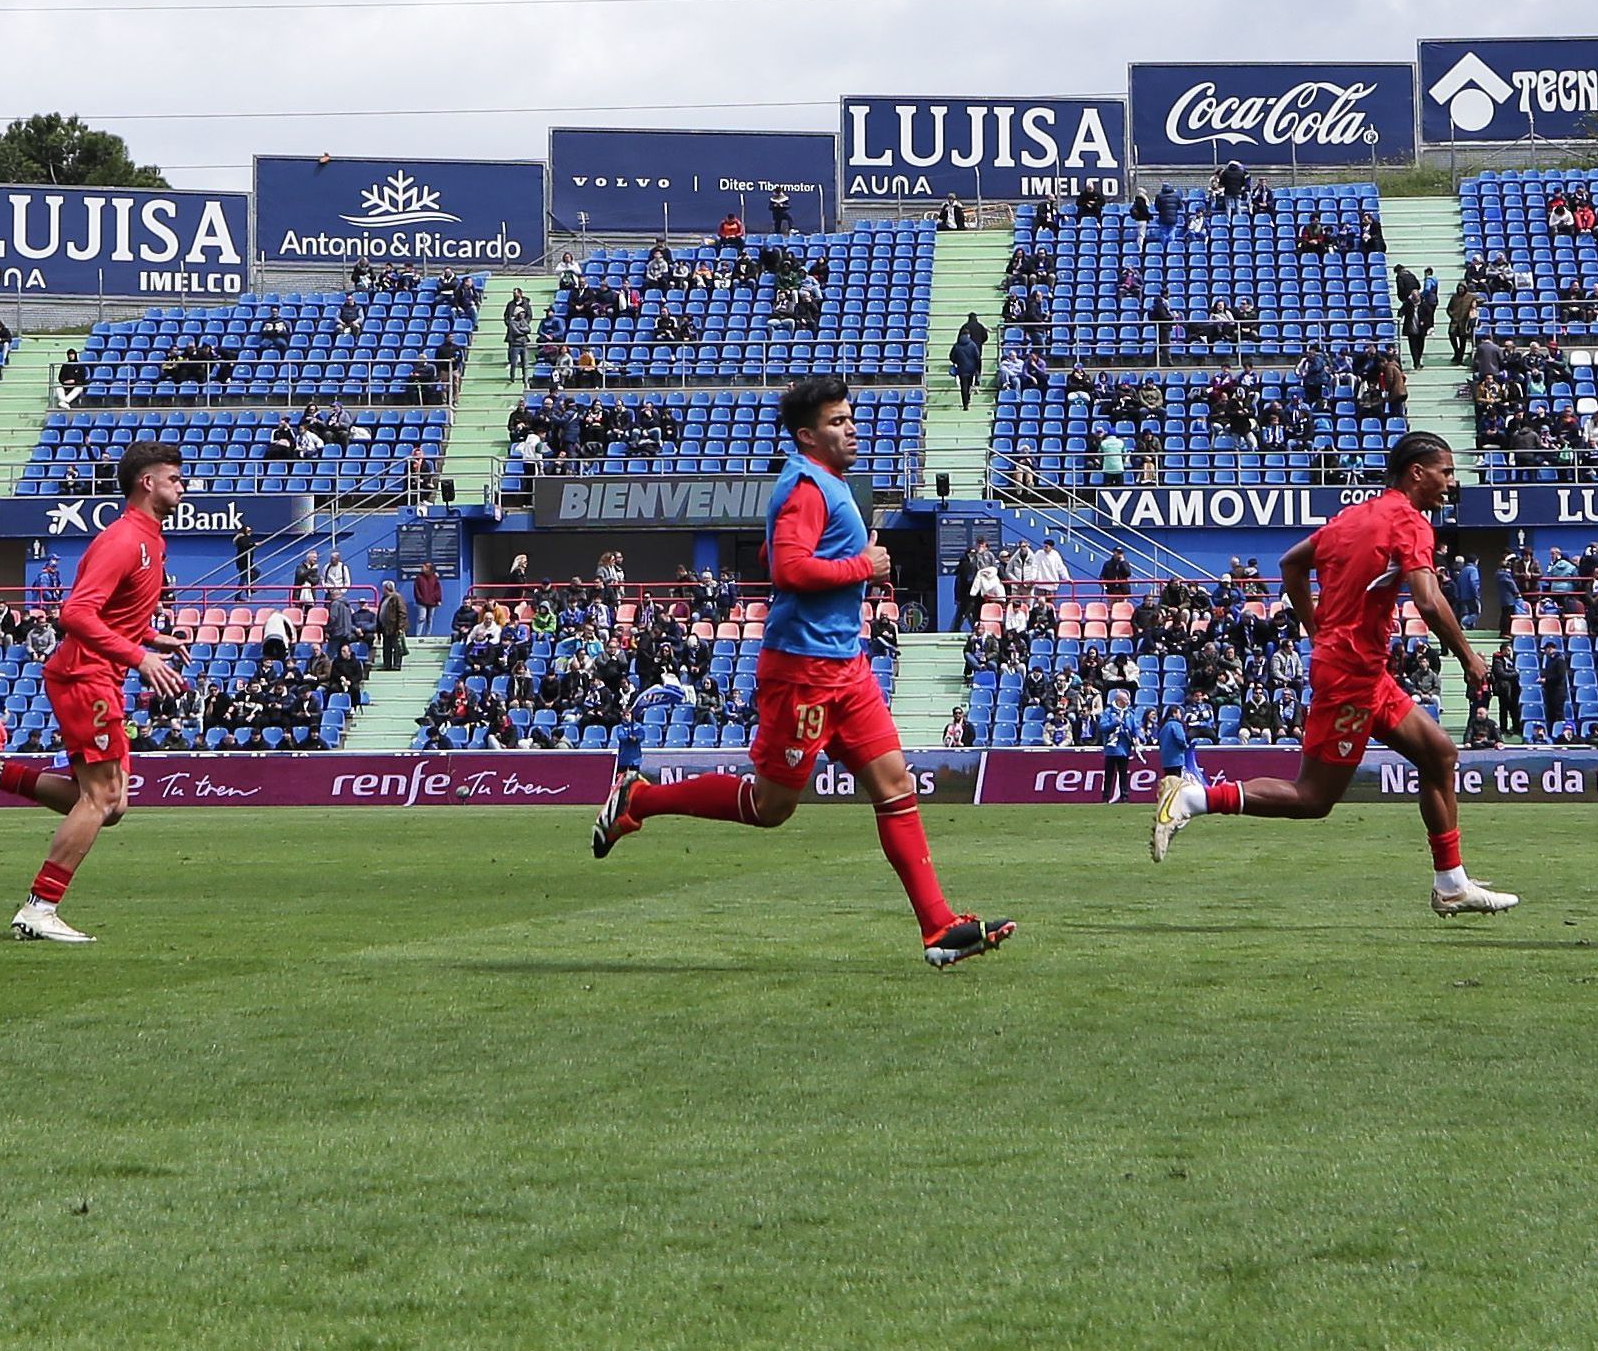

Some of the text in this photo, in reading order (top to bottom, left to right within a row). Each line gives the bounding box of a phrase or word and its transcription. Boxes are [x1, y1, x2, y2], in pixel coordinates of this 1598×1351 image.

[1166, 82, 1377, 145] Coca-Cola
[849, 105, 1118, 168] LUJISA
[573, 177, 670, 188] VOLVO
[719, 178, 754, 191] Ditec
[140, 271, 241, 293] IMELCO
[1100, 490, 1327, 526] YAMOVIL
[93, 700, 108, 727] 2
[796, 704, 824, 740] 19
[1335, 704, 1369, 733] 22
[158, 772, 189, 797] Tu
[196, 774, 261, 797] tren
[331, 760, 569, 806] renfe Tu tren
[815, 765, 855, 795] da
[1494, 765, 1529, 792] te
[1542, 762, 1583, 792] da
